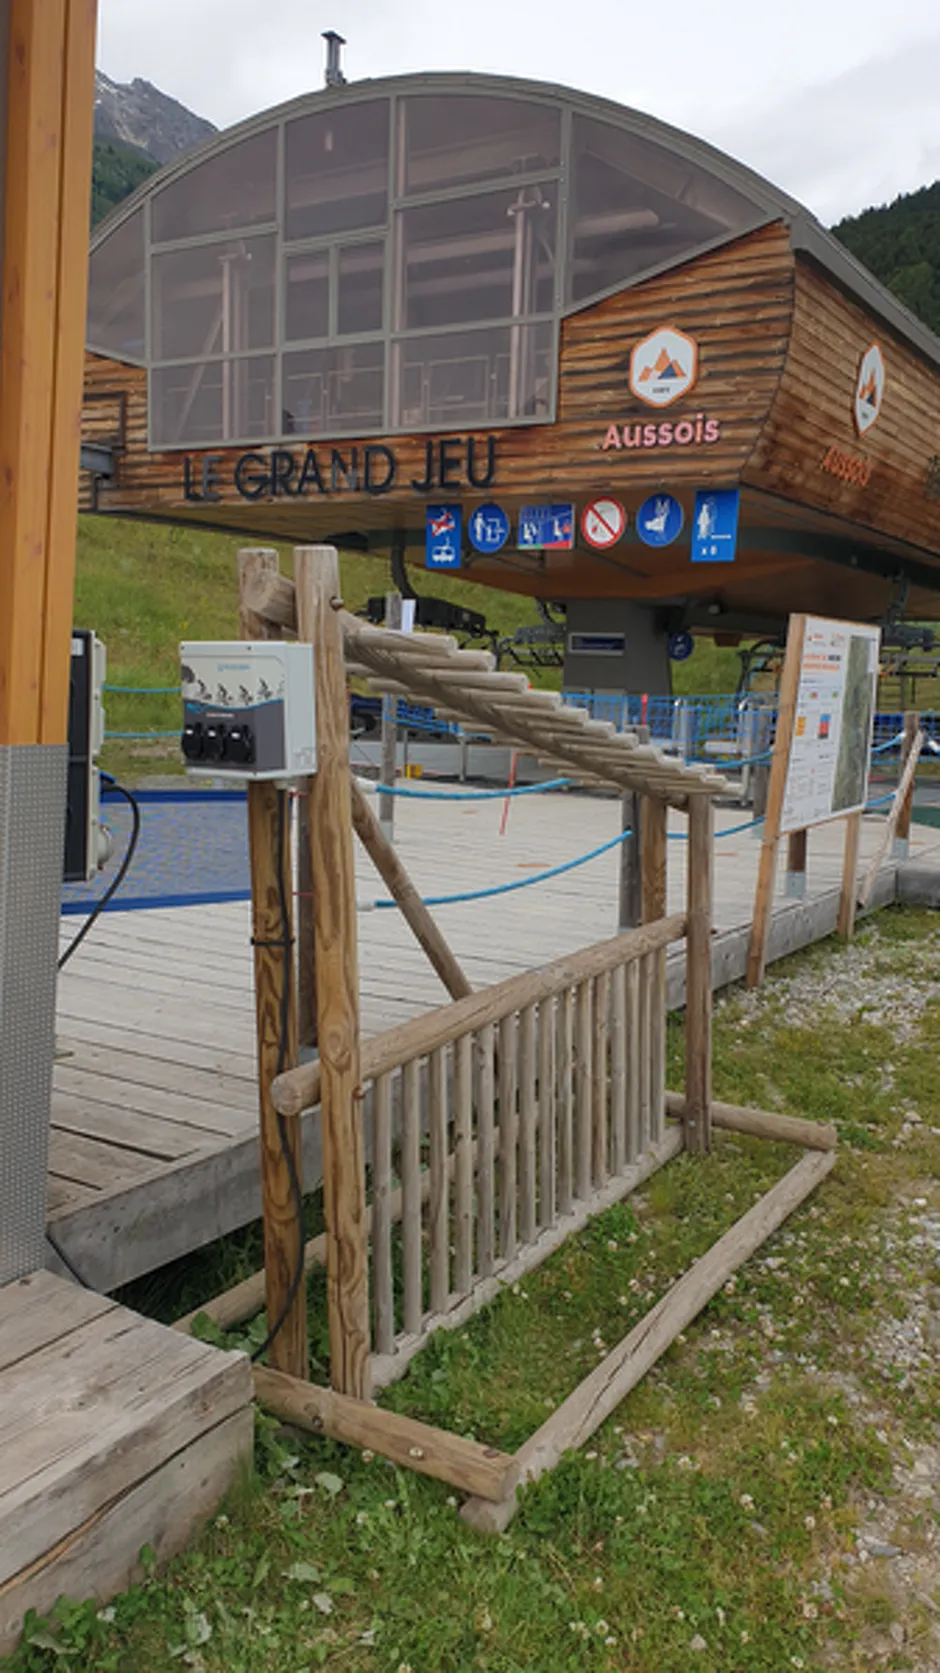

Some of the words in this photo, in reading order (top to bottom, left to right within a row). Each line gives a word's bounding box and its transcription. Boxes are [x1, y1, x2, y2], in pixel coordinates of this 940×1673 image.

[602, 413, 720, 451] Aussois
[183, 455, 221, 502] LE
[234, 444, 397, 500] GRAND
[411, 435, 496, 492] JEU
